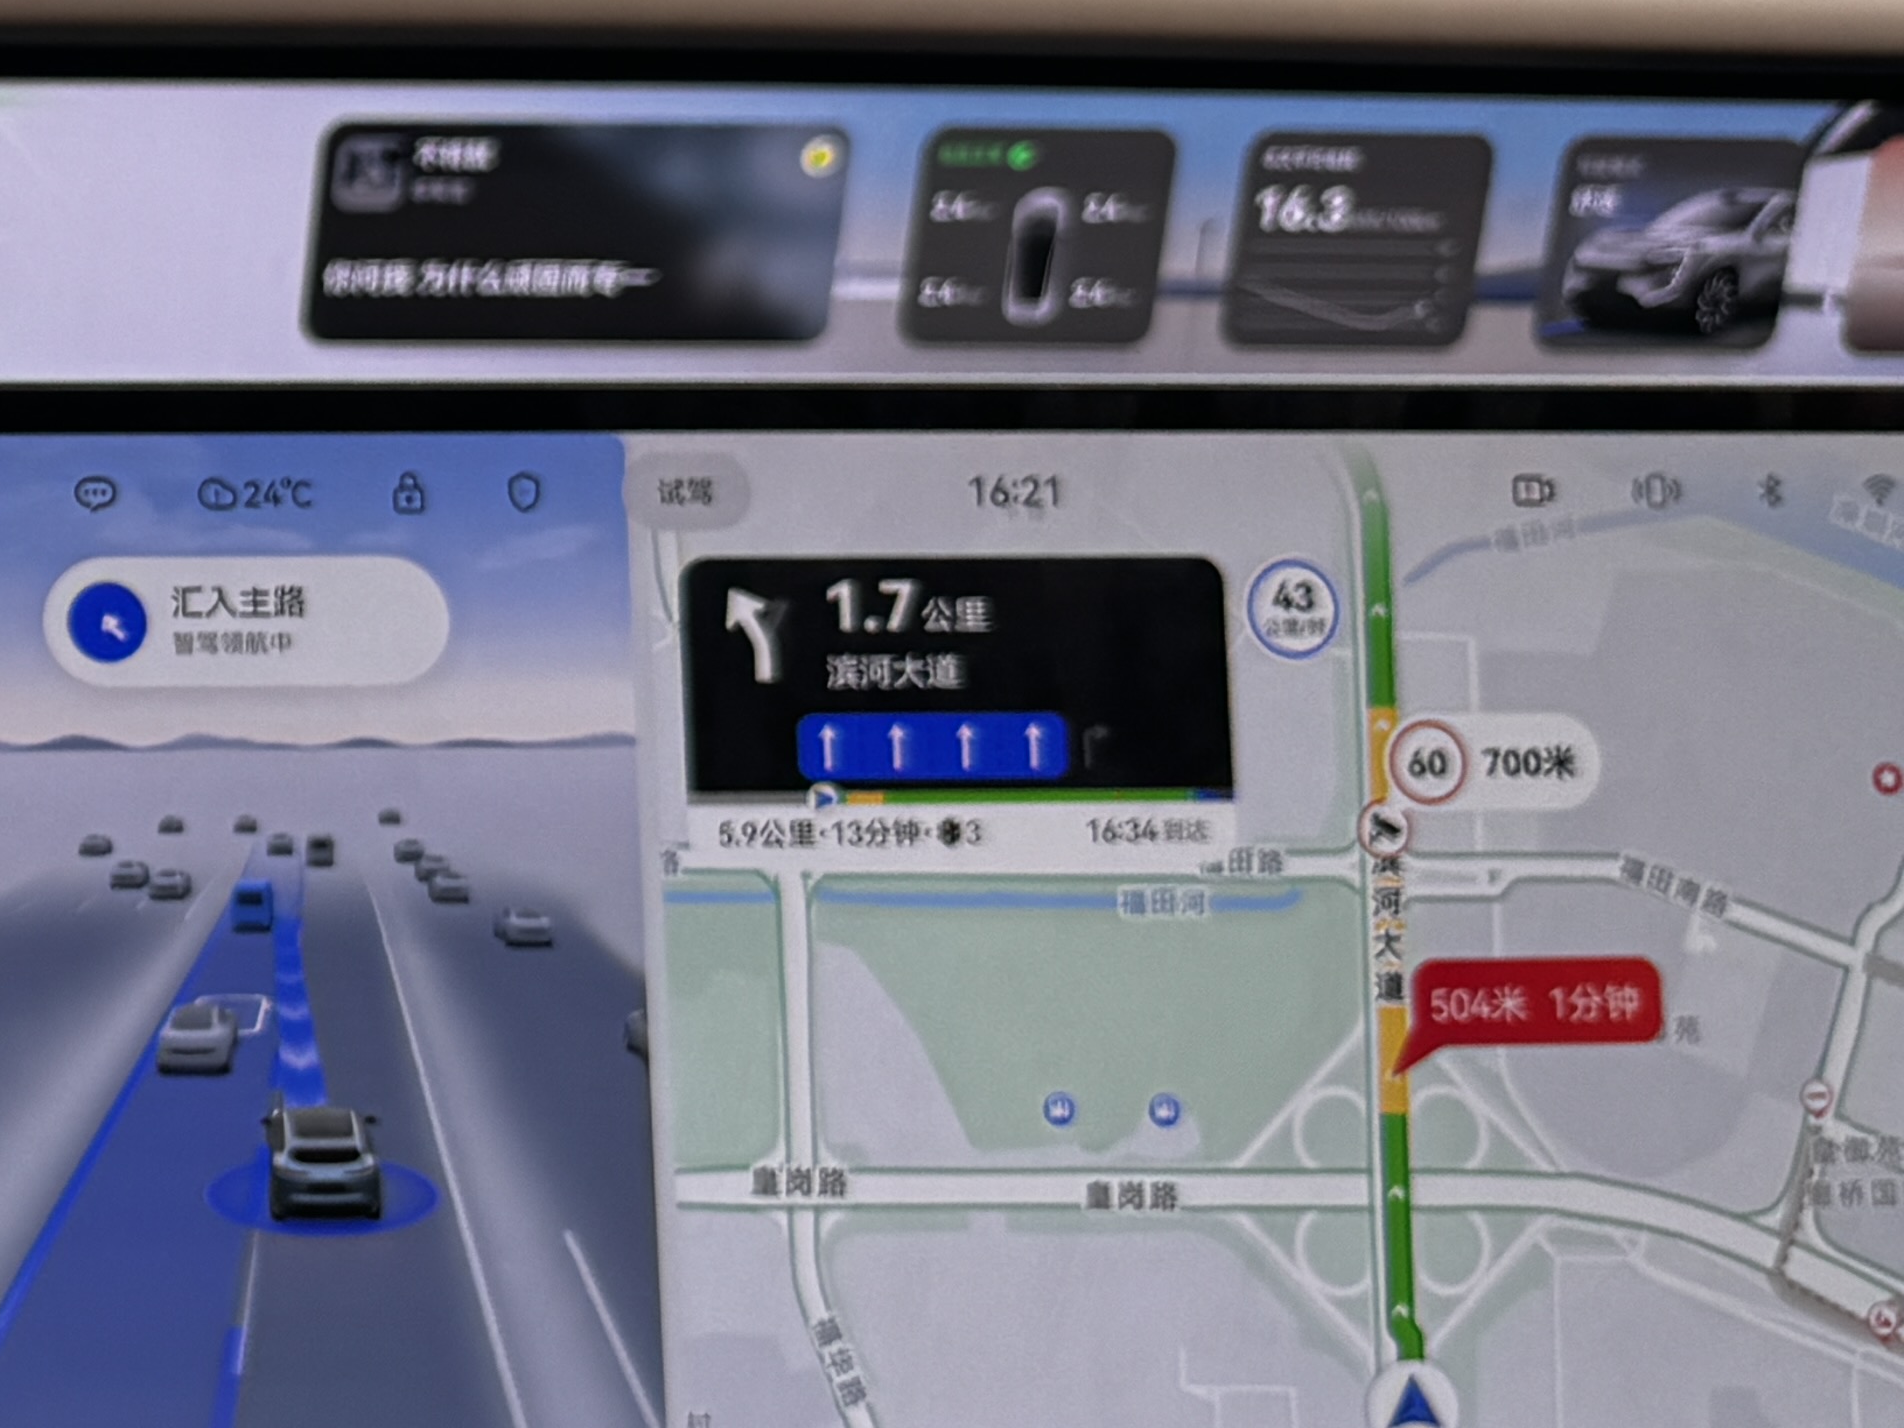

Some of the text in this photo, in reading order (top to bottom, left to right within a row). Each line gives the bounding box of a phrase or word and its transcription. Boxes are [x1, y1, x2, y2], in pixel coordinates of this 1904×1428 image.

[968, 475, 1062, 509] 16:21
[171, 585, 305, 619] 汇入主路
[1272, 578, 1314, 612] 43
[826, 652, 968, 691] 滨河大道
[1408, 747, 1449, 779] 60
[1482, 746, 1577, 780] 700米
[1429, 984, 1642, 1023] 504米 1分钟
